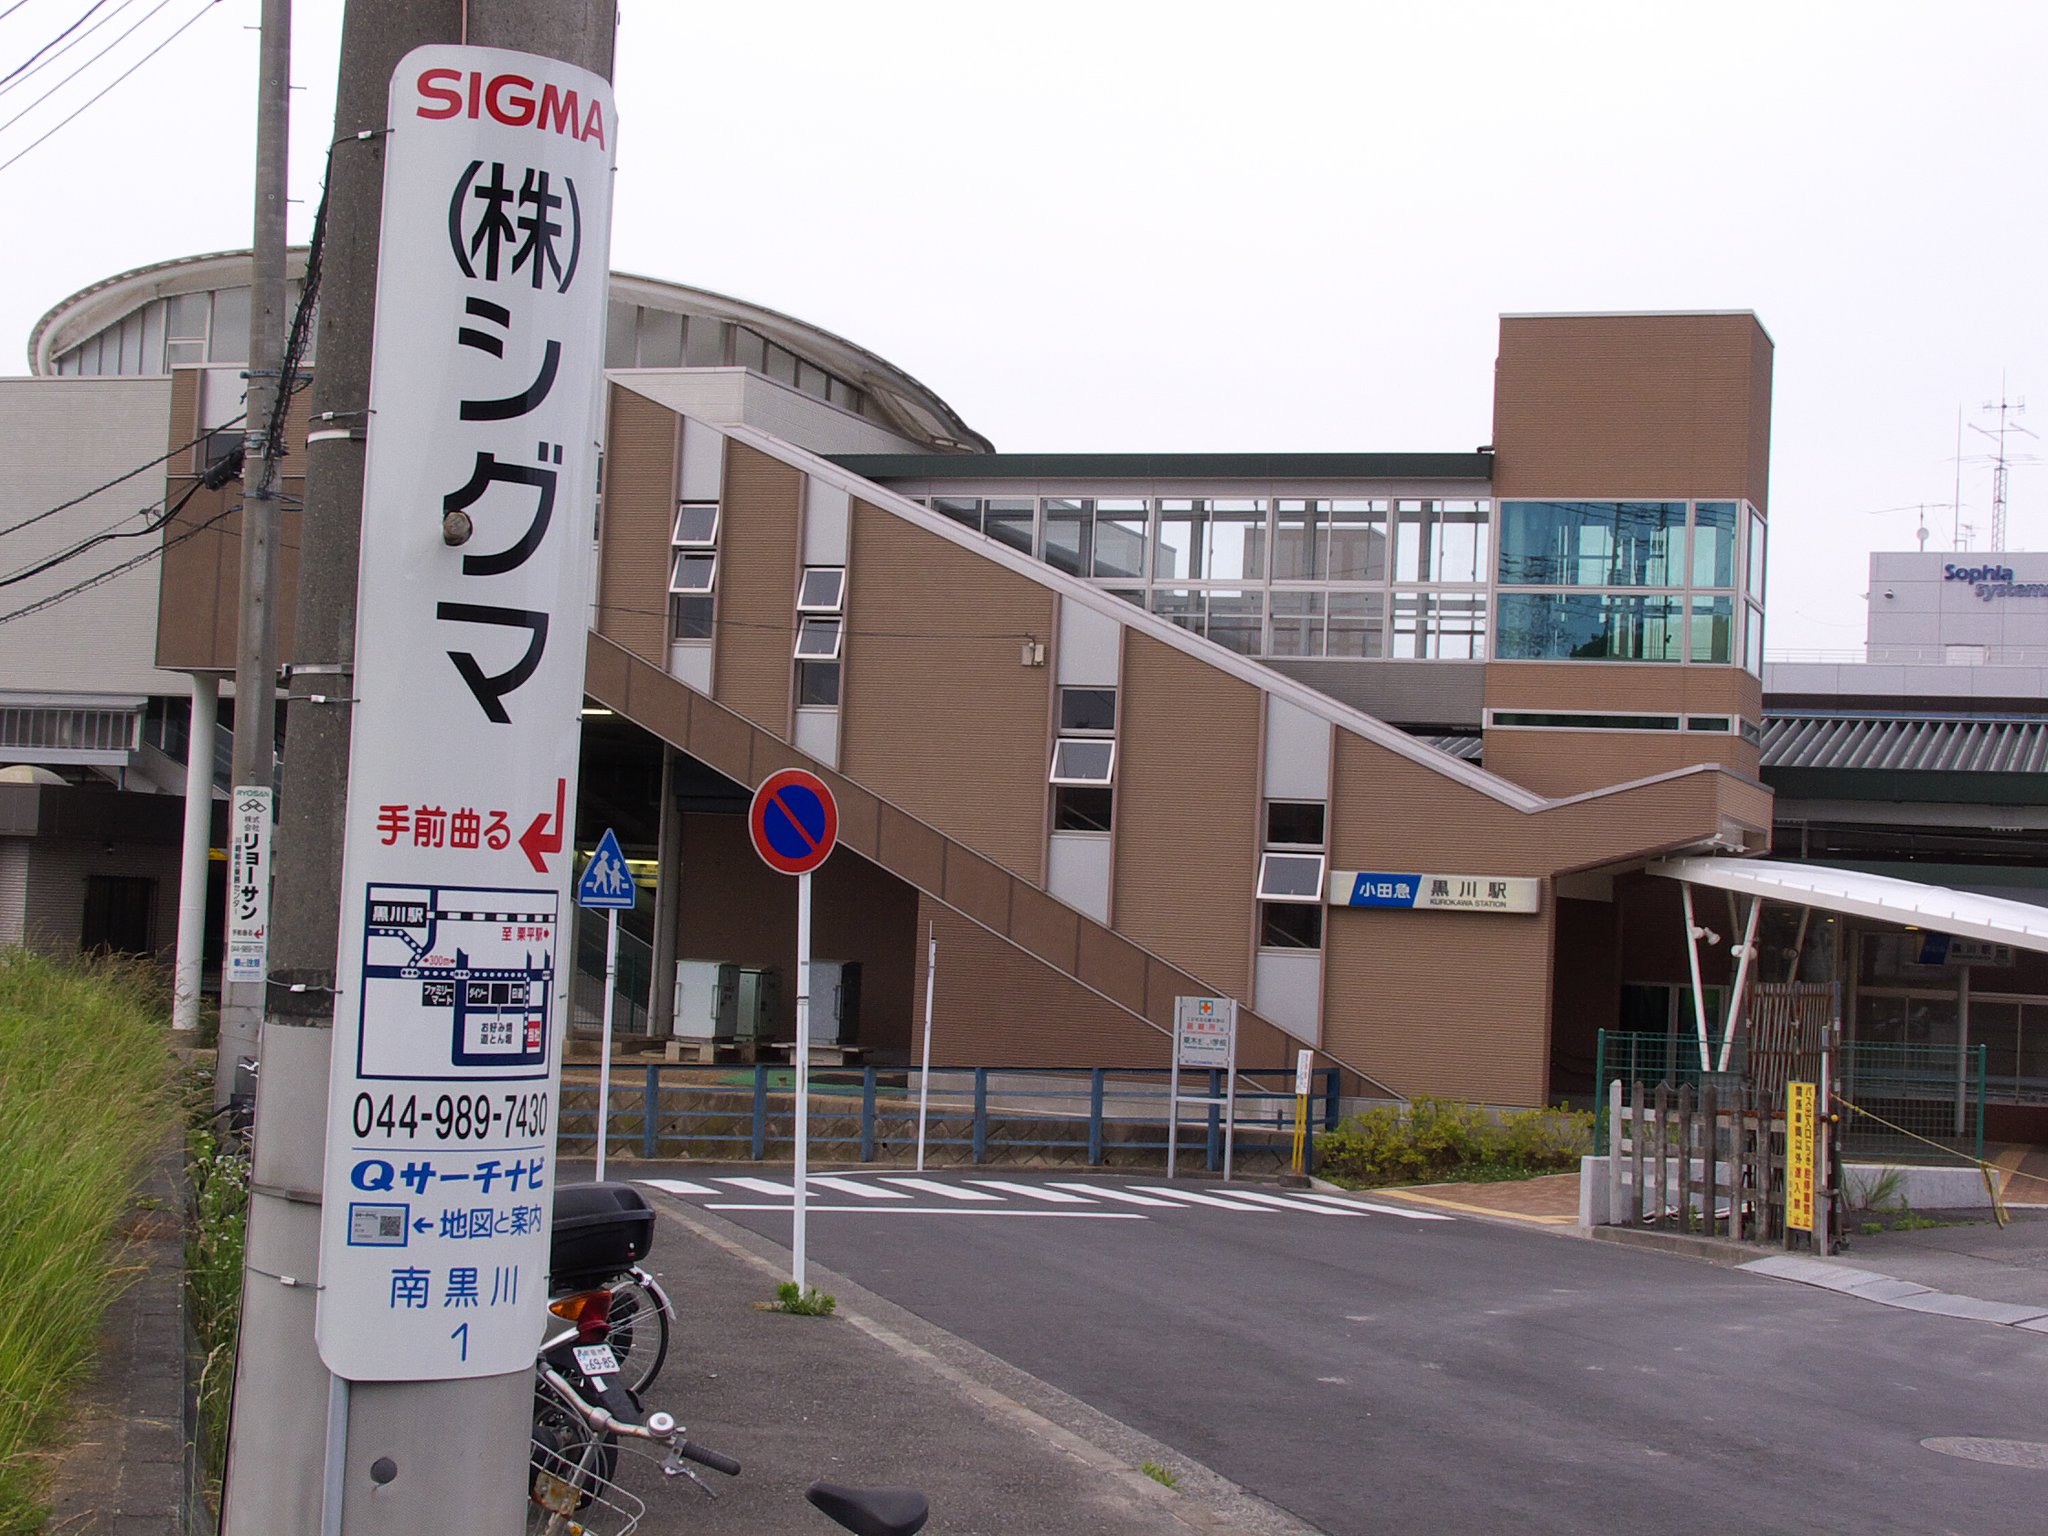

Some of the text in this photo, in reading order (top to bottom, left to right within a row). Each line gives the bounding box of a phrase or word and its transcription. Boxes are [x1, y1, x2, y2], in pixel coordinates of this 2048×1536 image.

[416, 67, 606, 152] SIGMA
[1944, 564, 2013, 585] Sophia
[377, 804, 512, 850] 手前曲る
[241, 833, 259, 920] リョーサン
[1359, 880, 1507, 899] 小田急 黒川駅
[372, 905, 424, 923] 黒川駅
[1430, 899, 1507, 909] KUROKAWA STATION
[429, 956, 451, 967] 300m
[424, 984, 454, 995] ファミリー
[431, 995, 454, 1006] マート
[353, 1092, 548, 1139] 044-989-7430
[351, 1156, 545, 1194] Qサーチナビ
[439, 1204, 542, 1239] 地図と案内
[390, 1265, 518, 1309] 南黒川
[451, 1322, 468, 1362] 1
